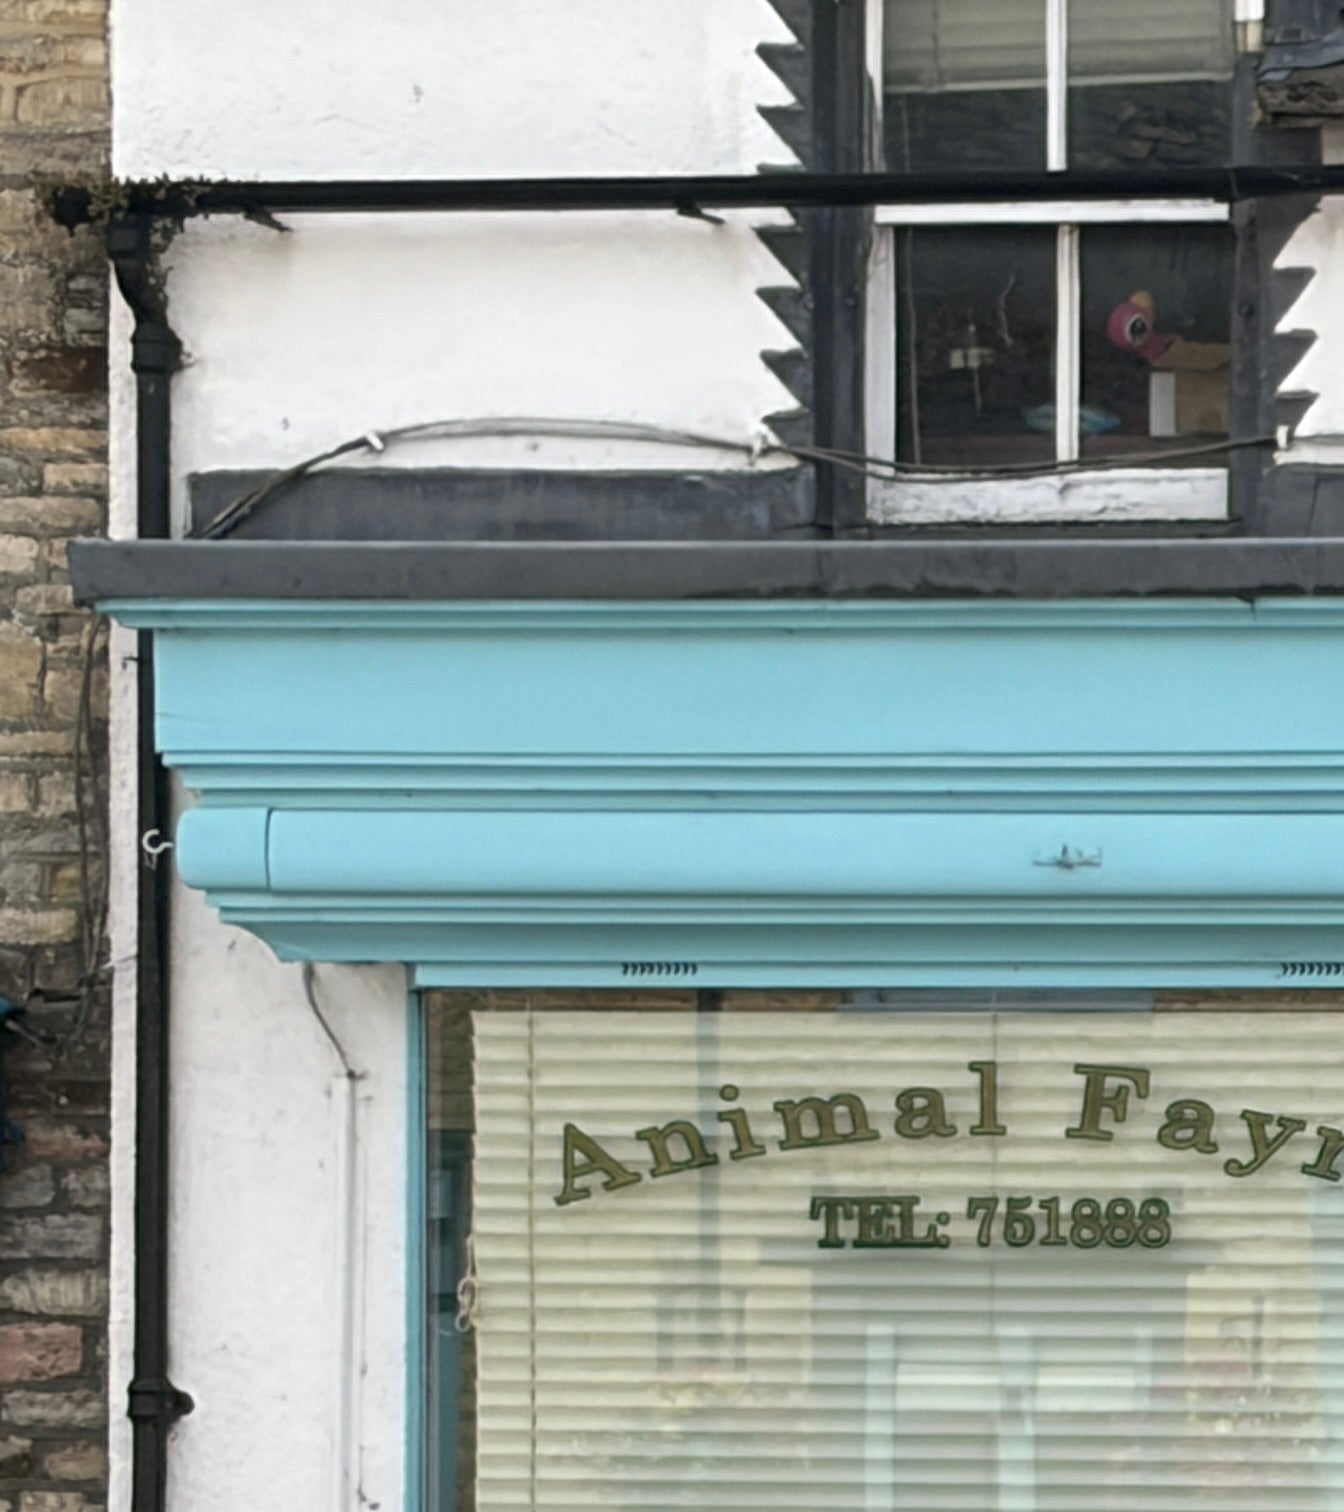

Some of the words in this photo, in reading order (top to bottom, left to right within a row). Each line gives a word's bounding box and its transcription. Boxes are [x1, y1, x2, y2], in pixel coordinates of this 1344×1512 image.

[553, 1060, 1006, 1206] Animal
[809, 1195, 951, 1248] TEL:
[966, 1196, 1171, 1249] 751888
